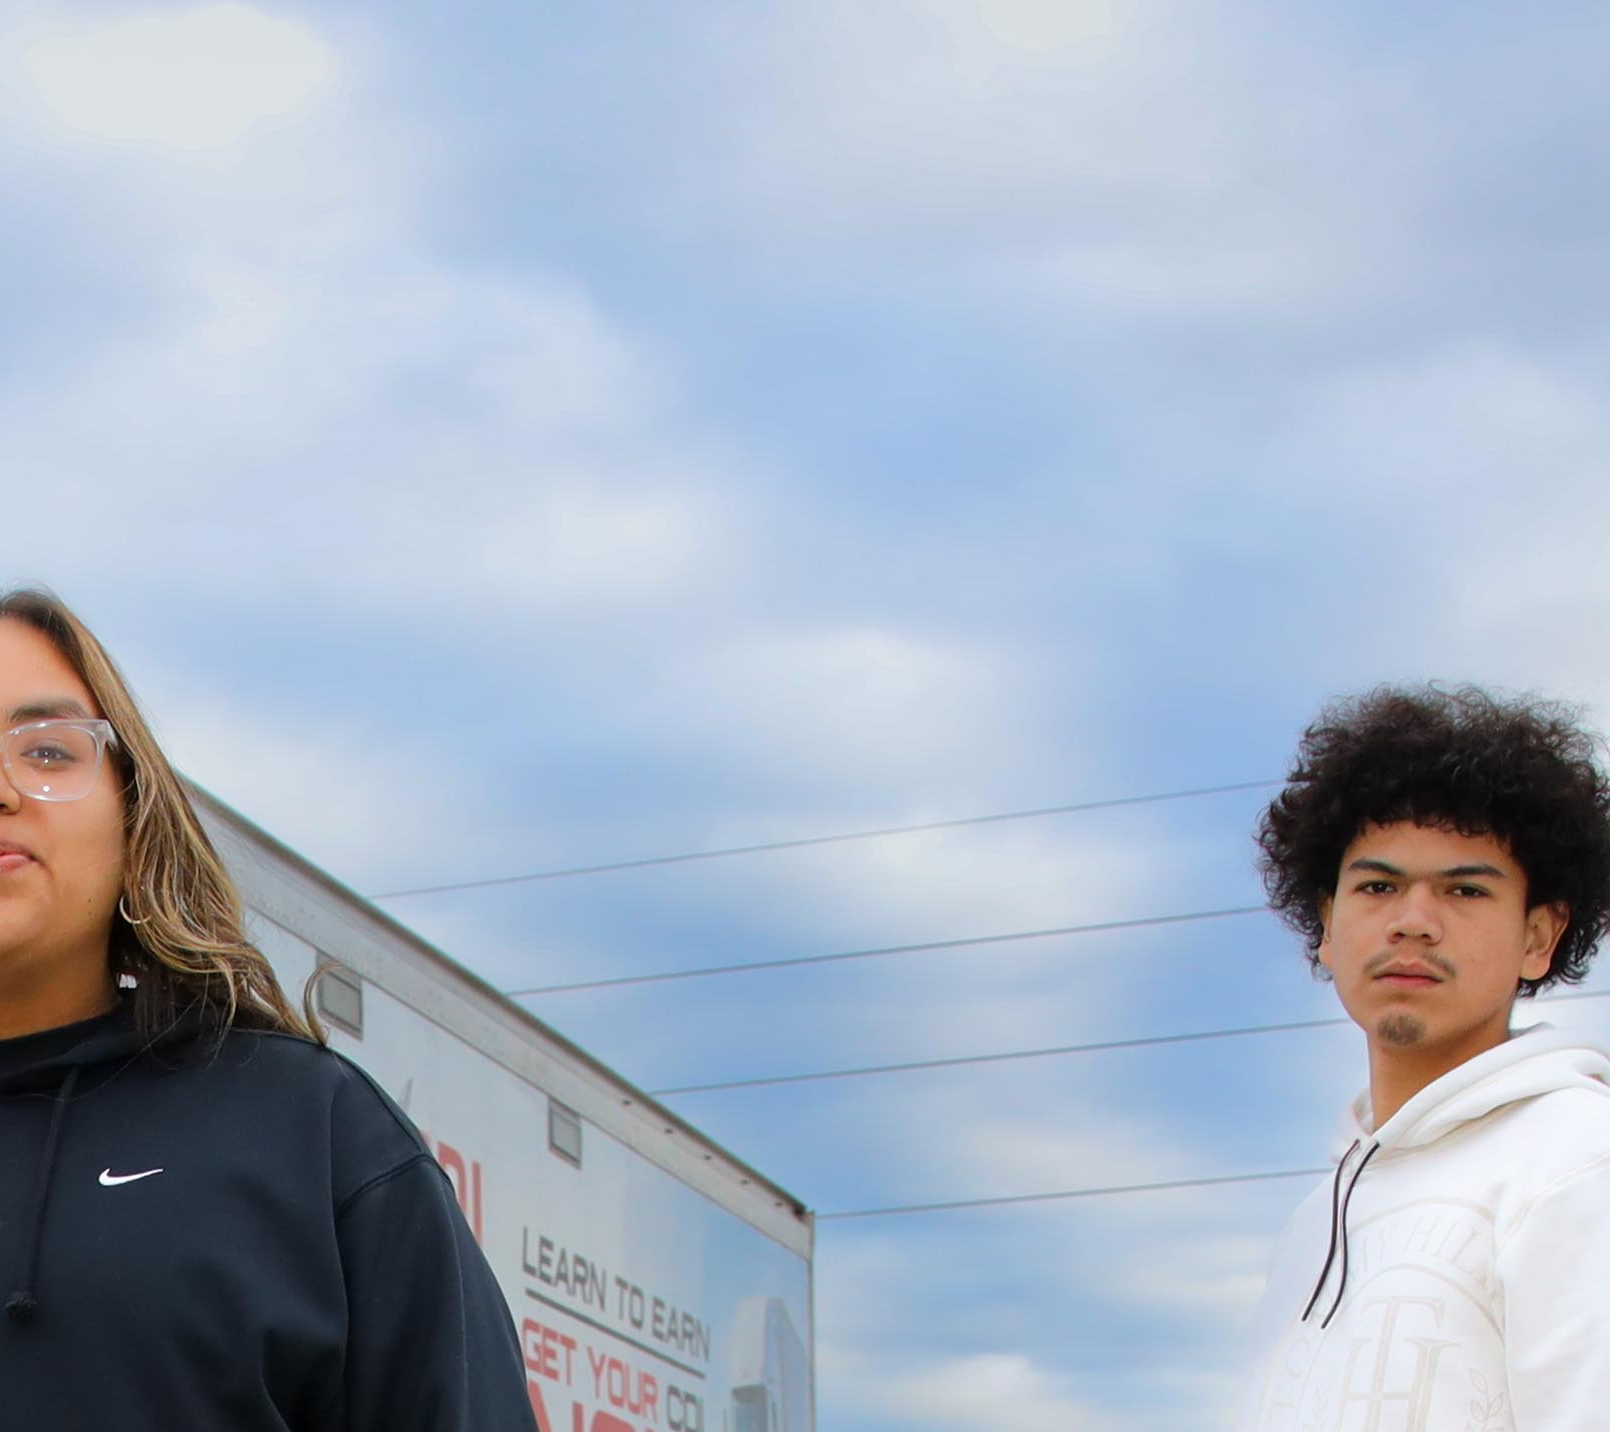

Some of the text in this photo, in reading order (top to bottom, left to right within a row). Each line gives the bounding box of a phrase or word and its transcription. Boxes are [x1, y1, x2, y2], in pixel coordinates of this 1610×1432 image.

[522, 1226, 711, 1363] LEARN TO EARN
[522, 1317, 577, 1387] GET
[587, 1346, 659, 1424] YOUR
